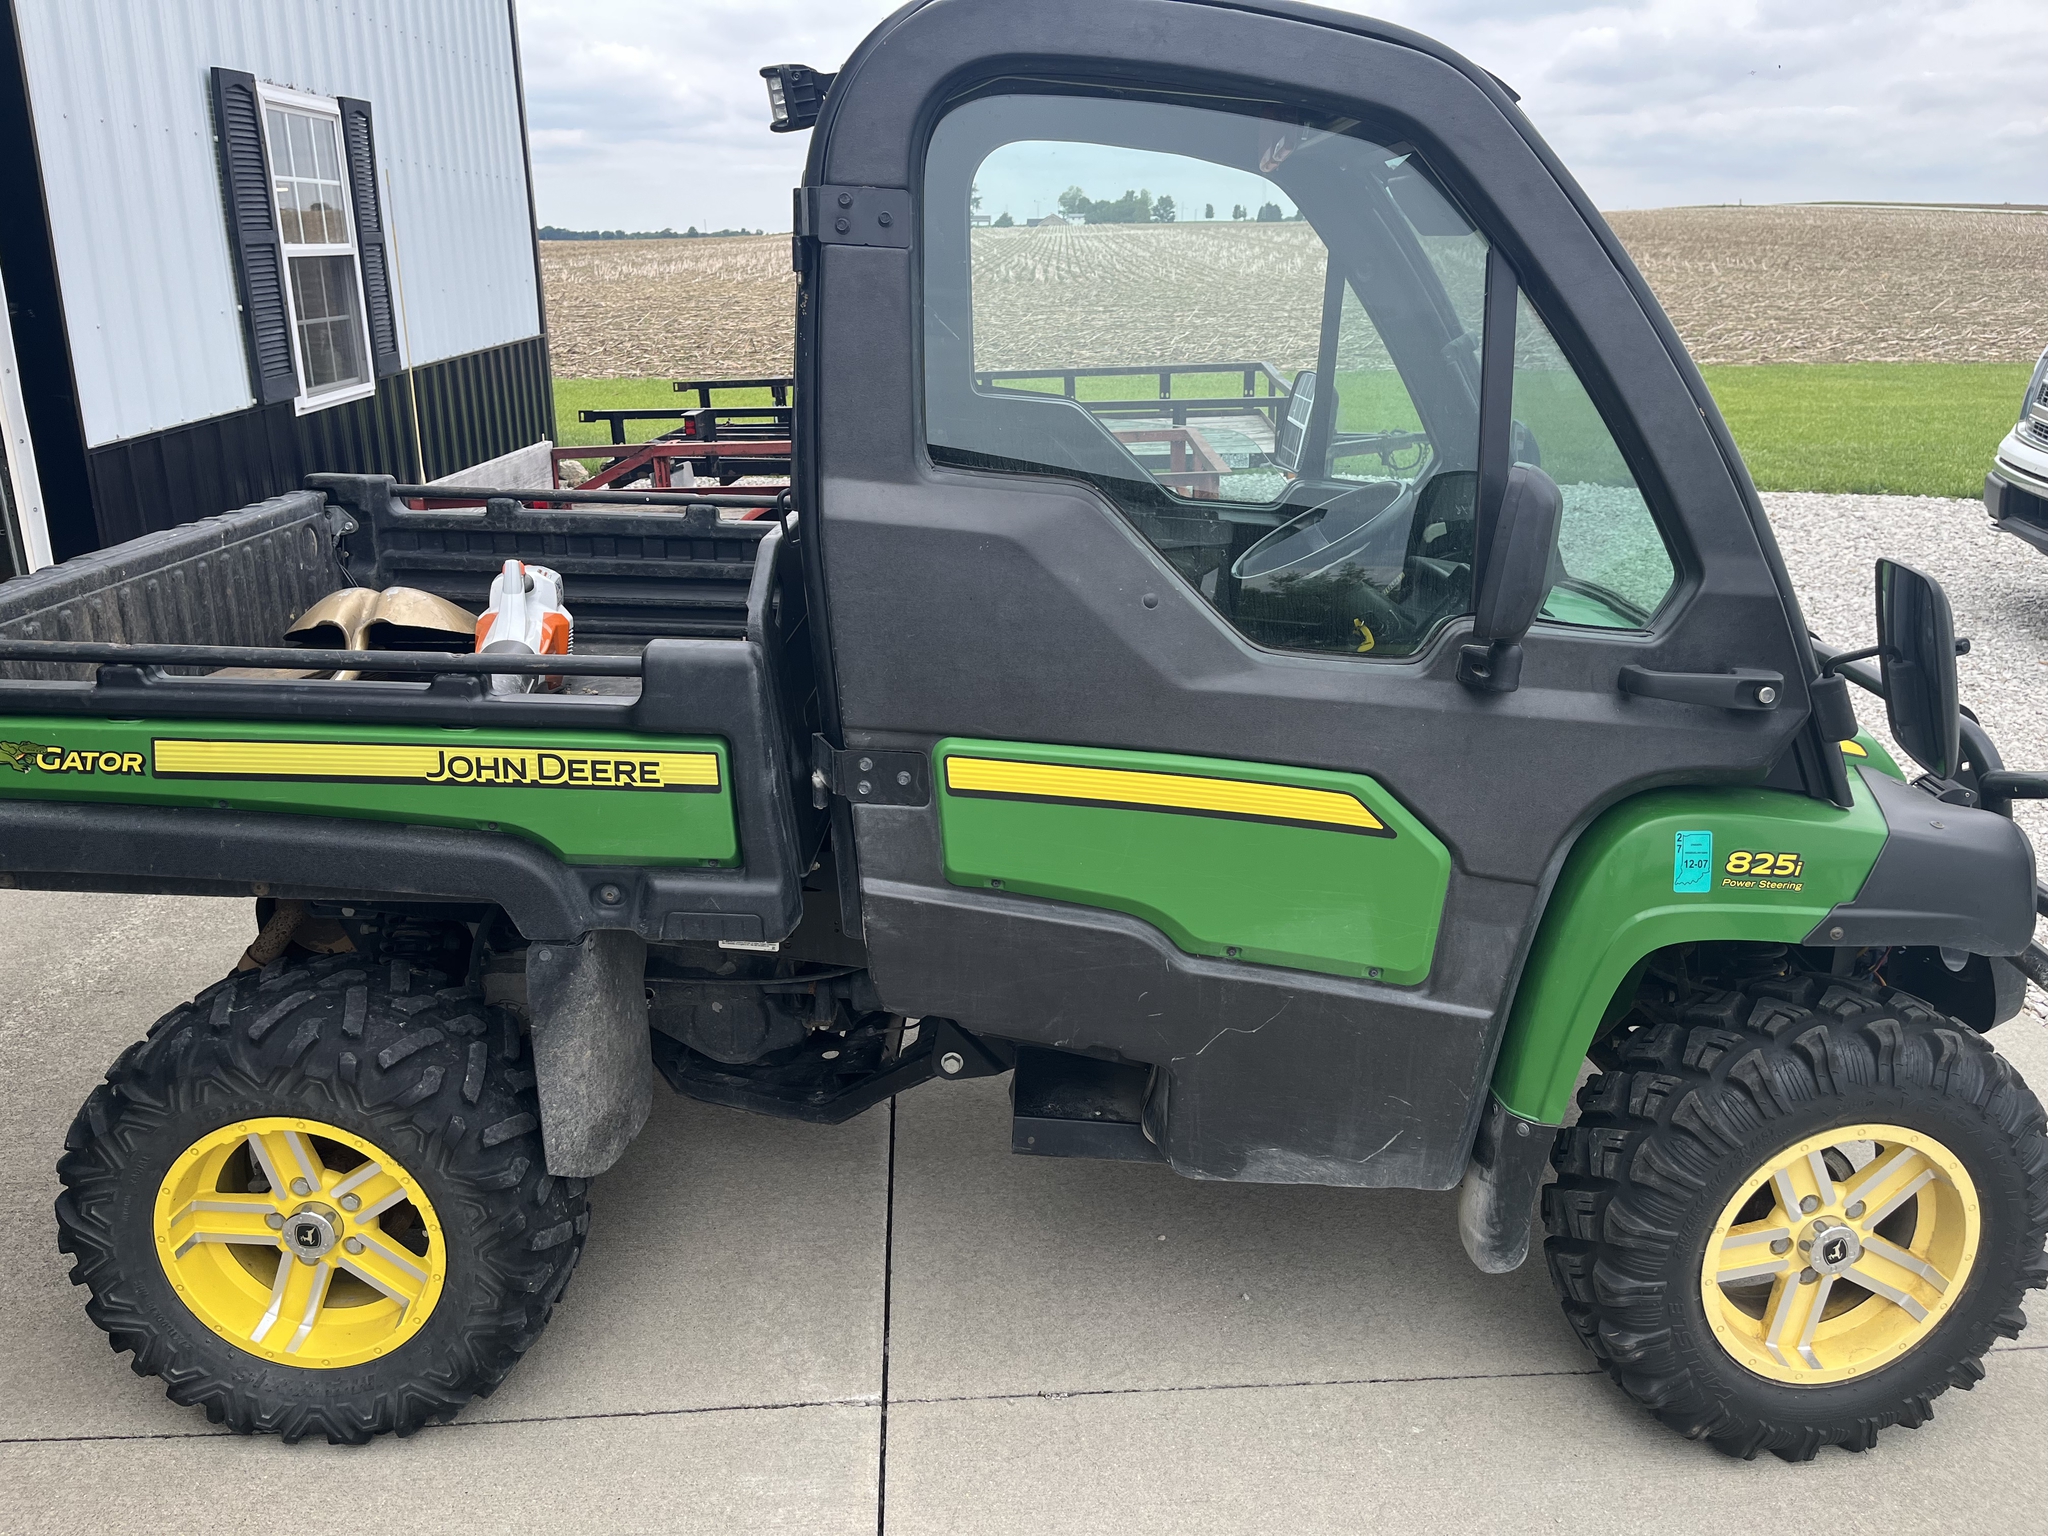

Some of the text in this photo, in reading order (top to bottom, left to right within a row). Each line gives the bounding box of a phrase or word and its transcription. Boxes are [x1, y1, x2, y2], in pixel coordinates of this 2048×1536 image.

[37, 746, 143, 773] GATOR
[426, 750, 661, 784] JOHN DEERE
[1684, 859, 1709, 869] 12-07
[1725, 851, 1803, 876] 825i
[1721, 878, 1803, 892] Power Steering
[1667, 1302, 1739, 1400] CARLISLE
